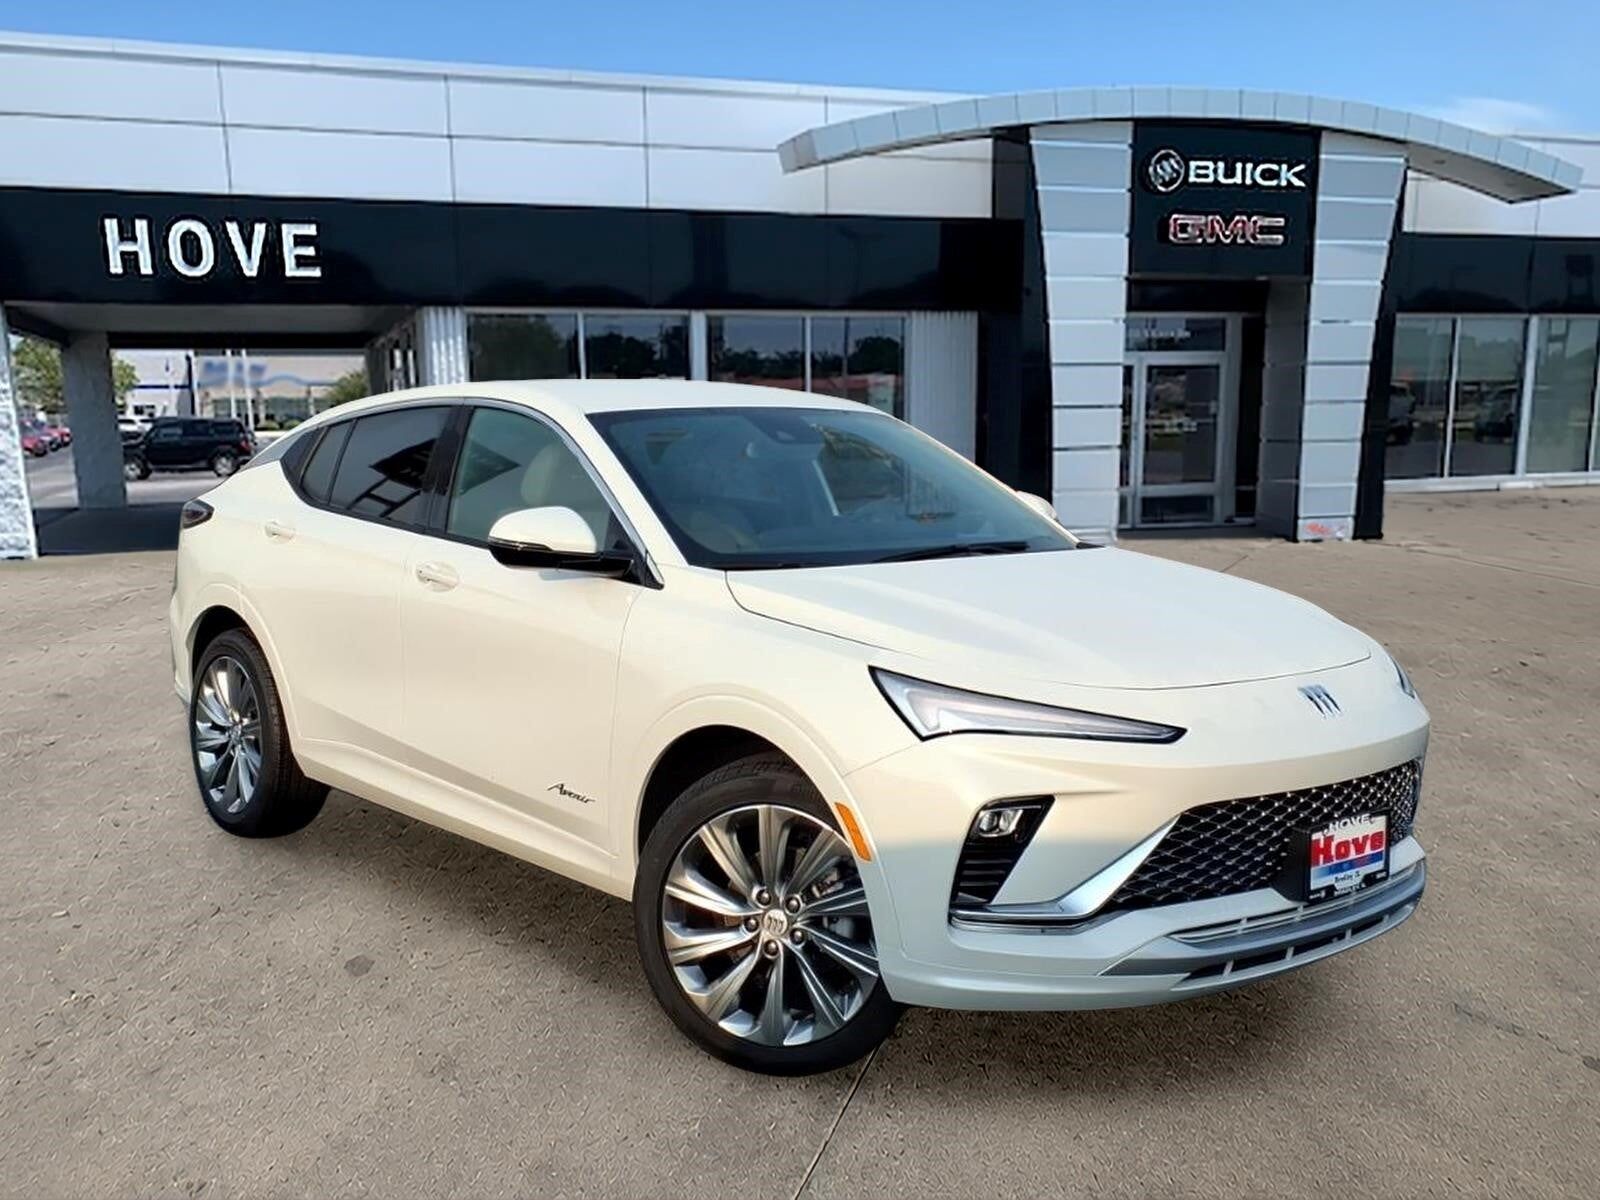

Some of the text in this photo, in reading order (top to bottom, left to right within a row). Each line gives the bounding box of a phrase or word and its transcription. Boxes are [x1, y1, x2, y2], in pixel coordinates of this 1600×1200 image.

[1188, 160, 1306, 188] BUICK
[1168, 213, 1286, 245] GMC
[103, 217, 322, 278] HOVE
[1311, 830, 1384, 867] Hove
